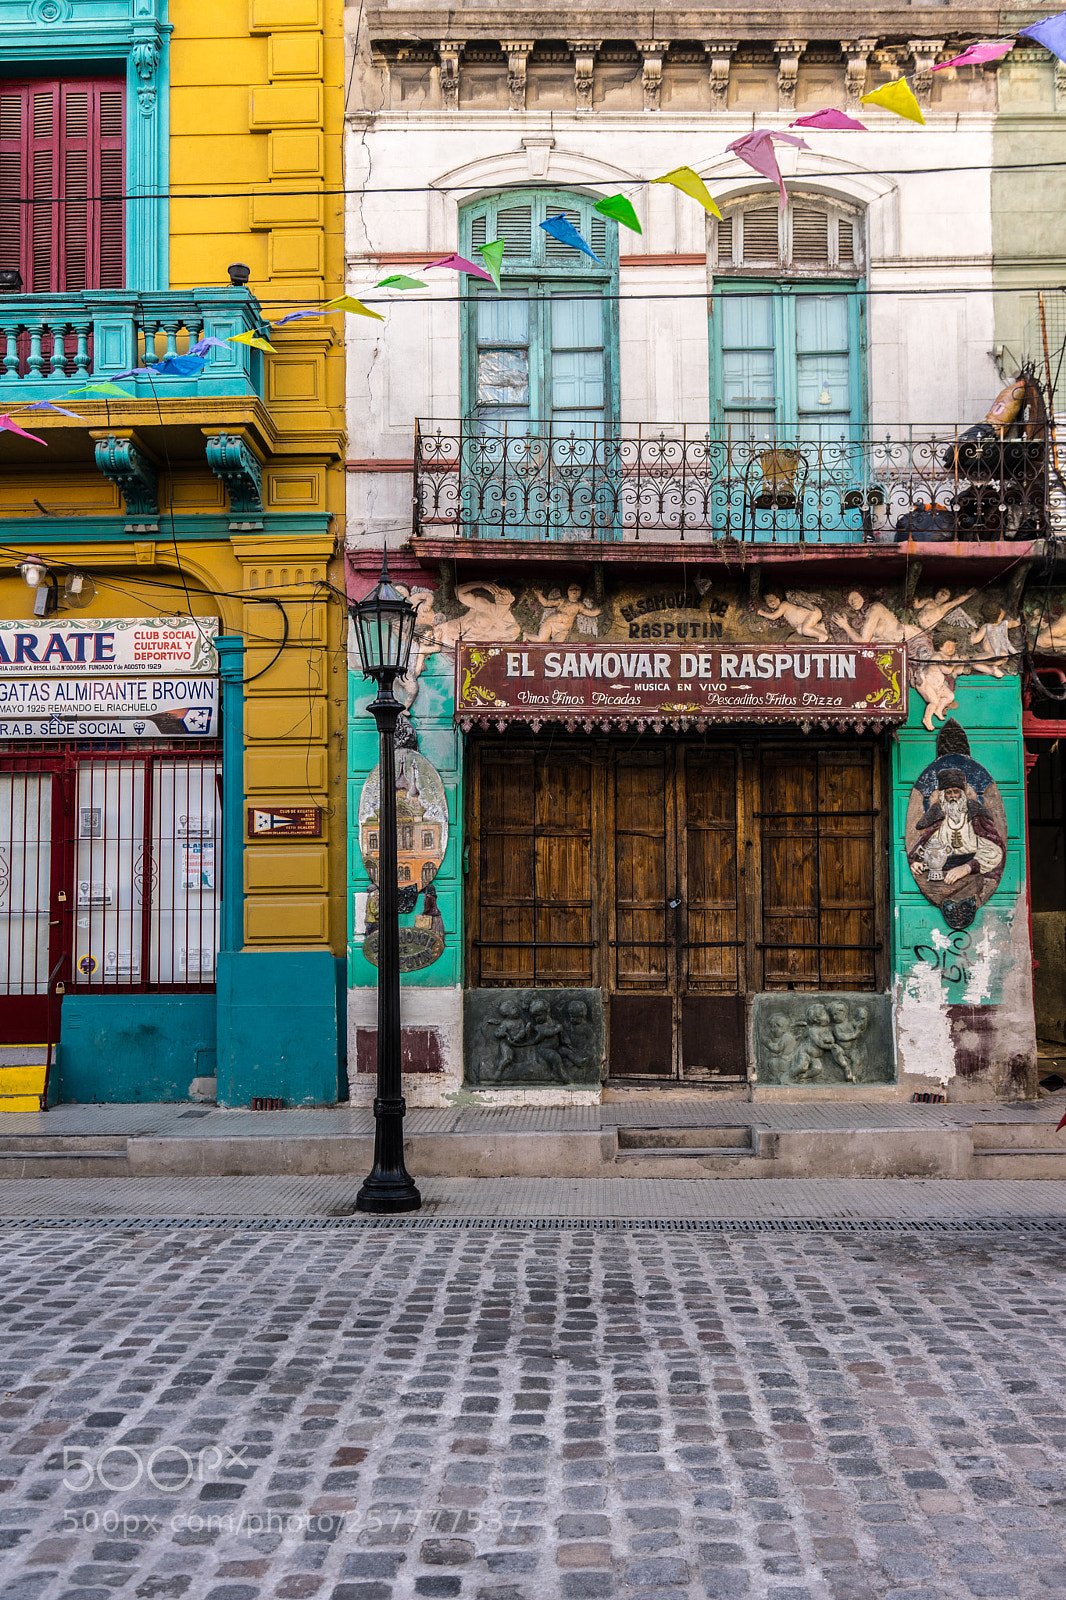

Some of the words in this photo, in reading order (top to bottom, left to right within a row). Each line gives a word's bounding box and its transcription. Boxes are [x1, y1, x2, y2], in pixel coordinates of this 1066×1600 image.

[620, 603, 635, 622] EL
[710, 599, 729, 618] DE
[134, 631, 159, 640] CLUB
[163, 631, 196, 639] SOCIAL
[629, 622, 723, 638] RASPUTIN
[134, 642, 182, 650] CULTURAL
[134, 652, 191, 661] DEPORTIVO
[506, 652, 535, 677] EL
[544, 652, 671, 678] SAMOVAR
[680, 653, 713, 679] DE
[721, 653, 856, 679] RASPUTIN
[55, 682, 147, 700] ALMIRANTE
[153, 681, 214, 700] BROWN
[634, 683, 670, 692] MUSICA
[677, 683, 692, 692] EN
[699, 683, 727, 692] VIVO
[517, 691, 549, 705] Vinos
[551, 690, 585, 705] Finos
[591, 691, 641, 705] Picadas
[705, 692, 764, 706] Pescaditos
[765, 692, 797, 706] Fritos
[801, 692, 843, 706] Pizza
[27, 704, 46, 712] 1925
[48, 704, 91, 712] REMANDO
[94, 703, 105, 711] EL
[107, 703, 157, 711] RIACHUELO
[40, 723, 75, 735] SEDE
[79, 722, 126, 735] SOCIAL
